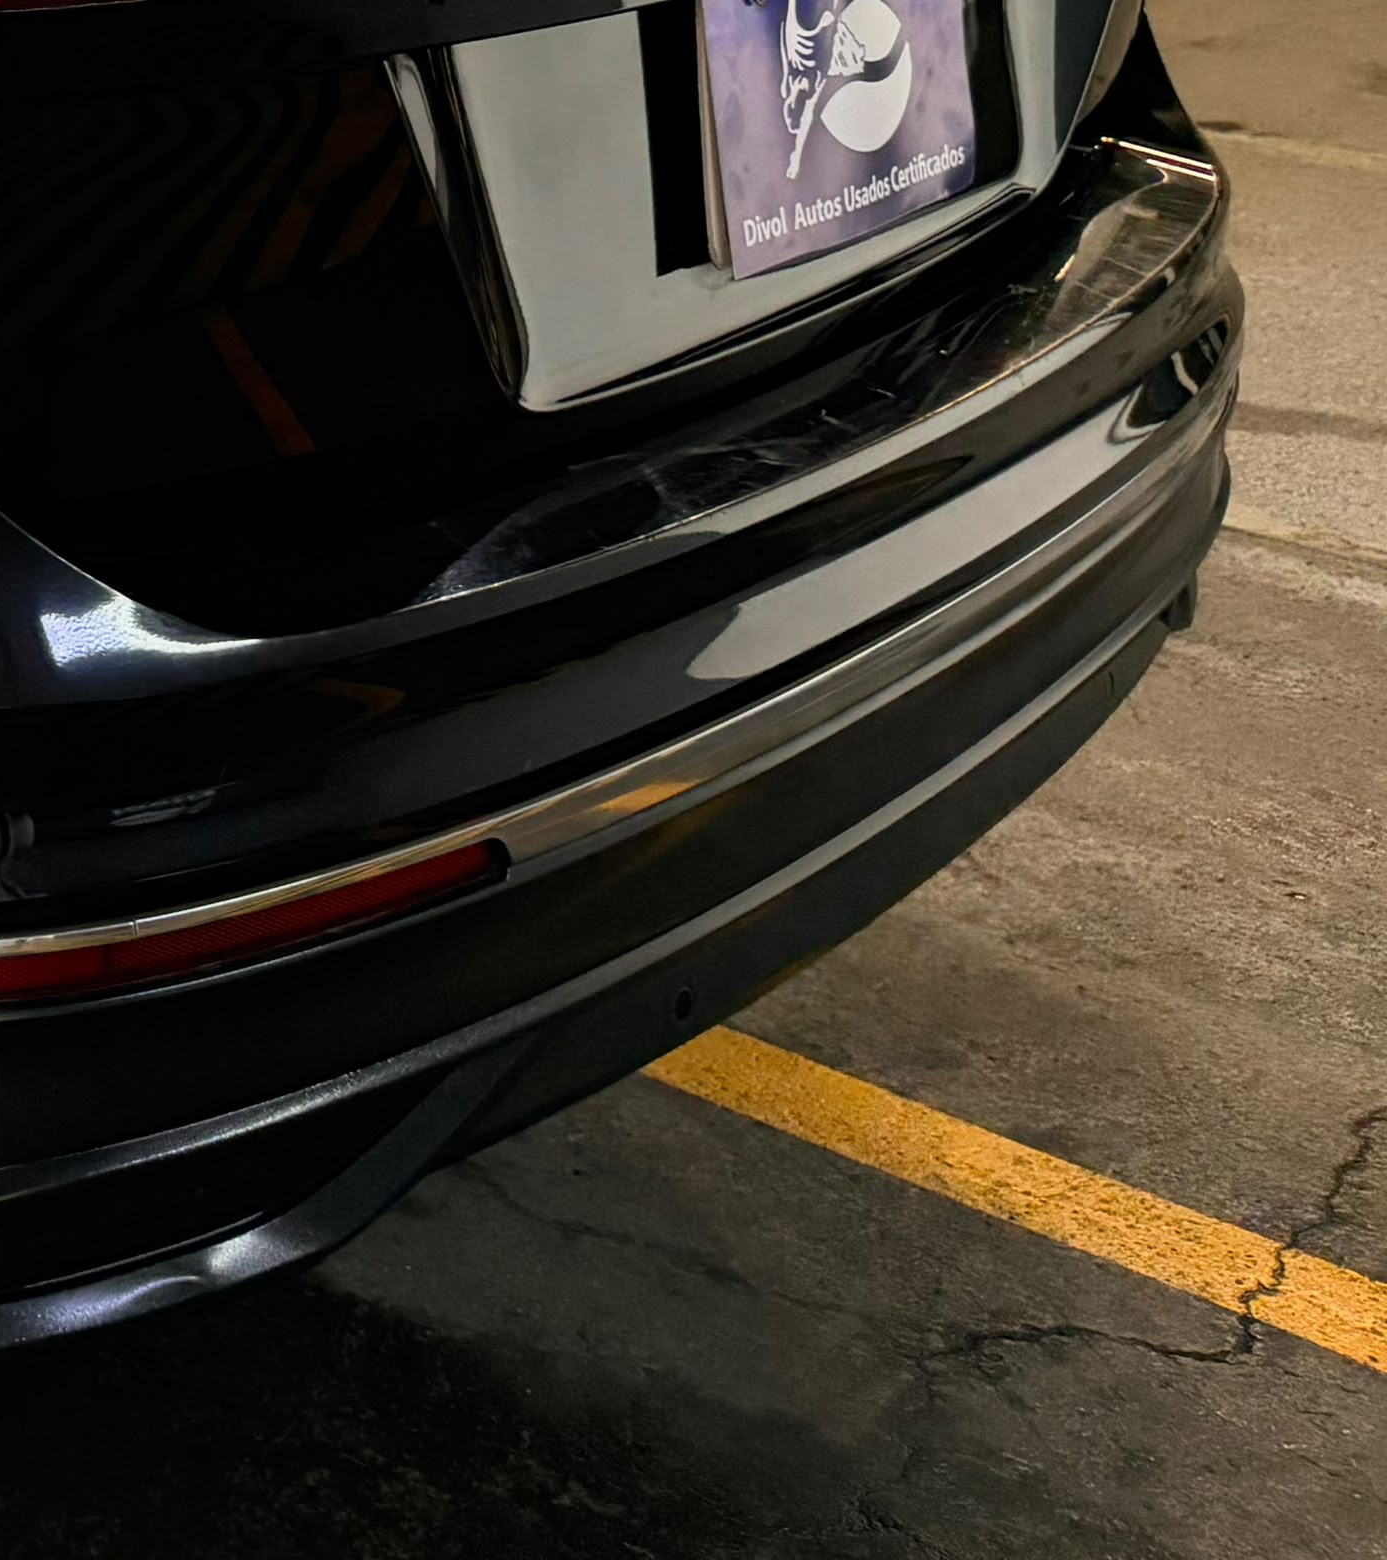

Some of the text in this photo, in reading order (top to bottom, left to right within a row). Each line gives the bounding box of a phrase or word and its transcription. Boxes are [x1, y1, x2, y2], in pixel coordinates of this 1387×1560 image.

[743, 144, 965, 247] Divol Autos Usados Certificados
